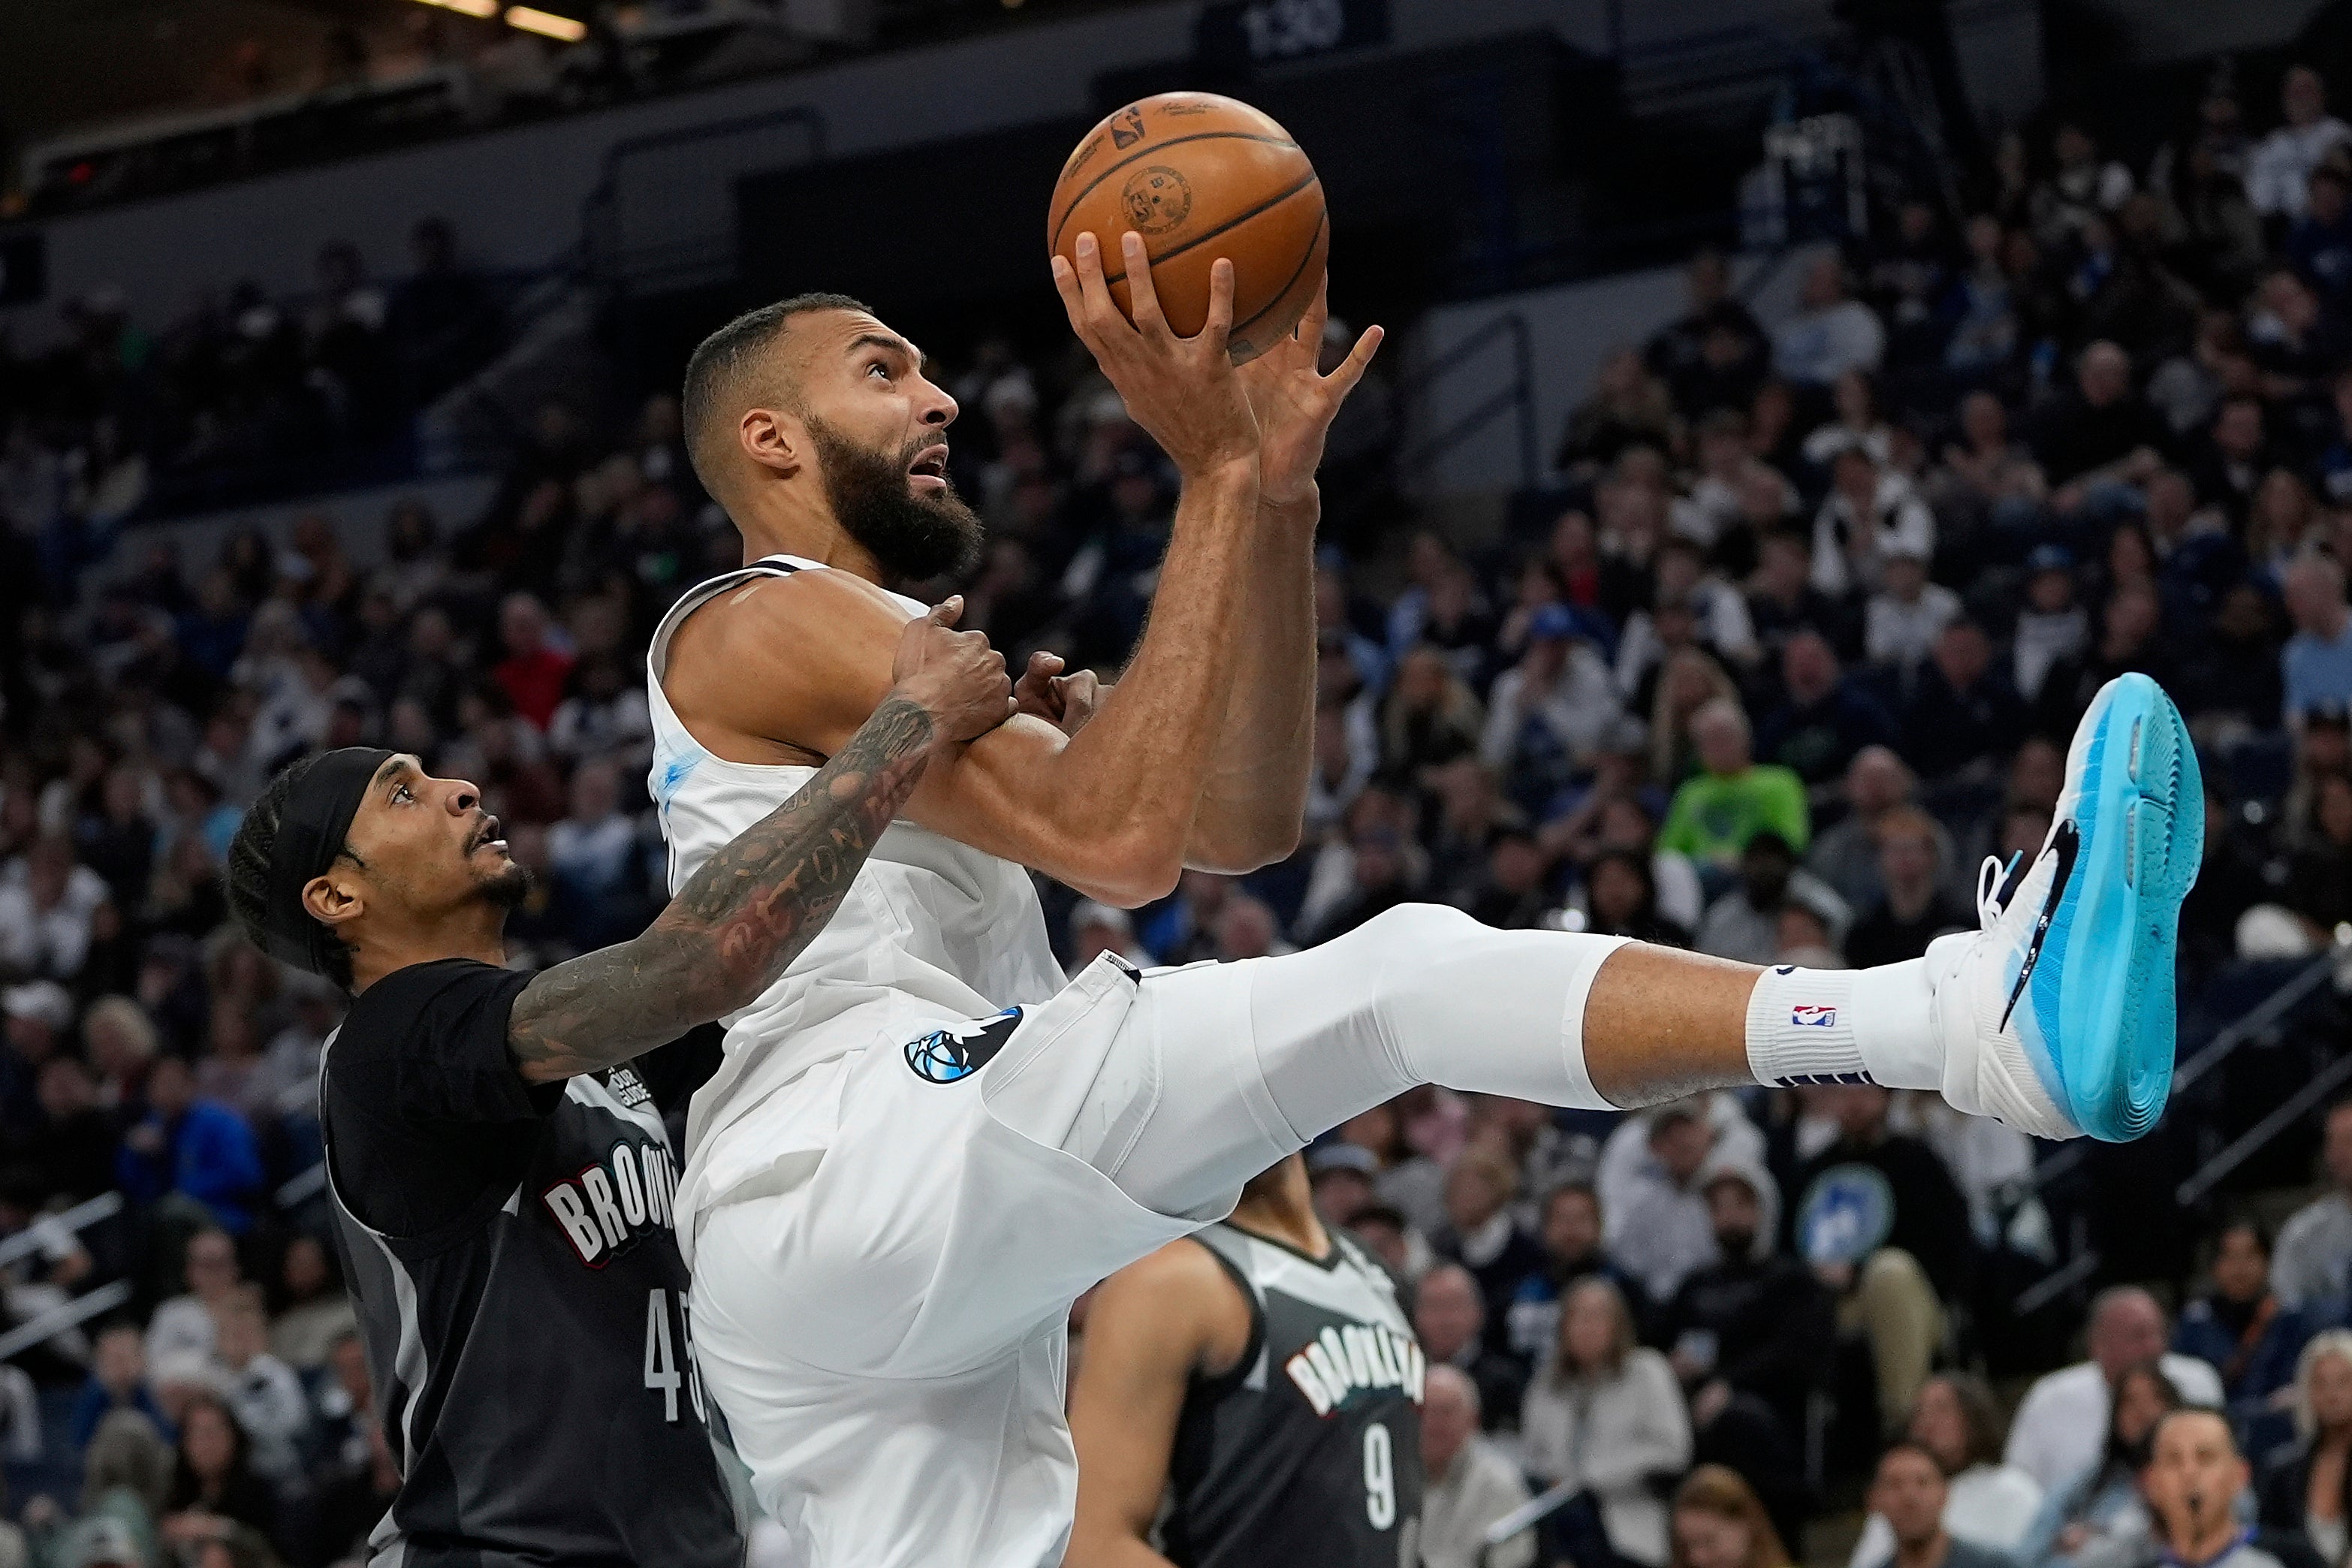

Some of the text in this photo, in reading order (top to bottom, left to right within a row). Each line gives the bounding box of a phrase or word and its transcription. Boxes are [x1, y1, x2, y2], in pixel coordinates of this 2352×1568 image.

[609, 1068, 638, 1090] OUR
[644, 1287, 707, 1425] 45
[1363, 1422, 1397, 1531] 9
